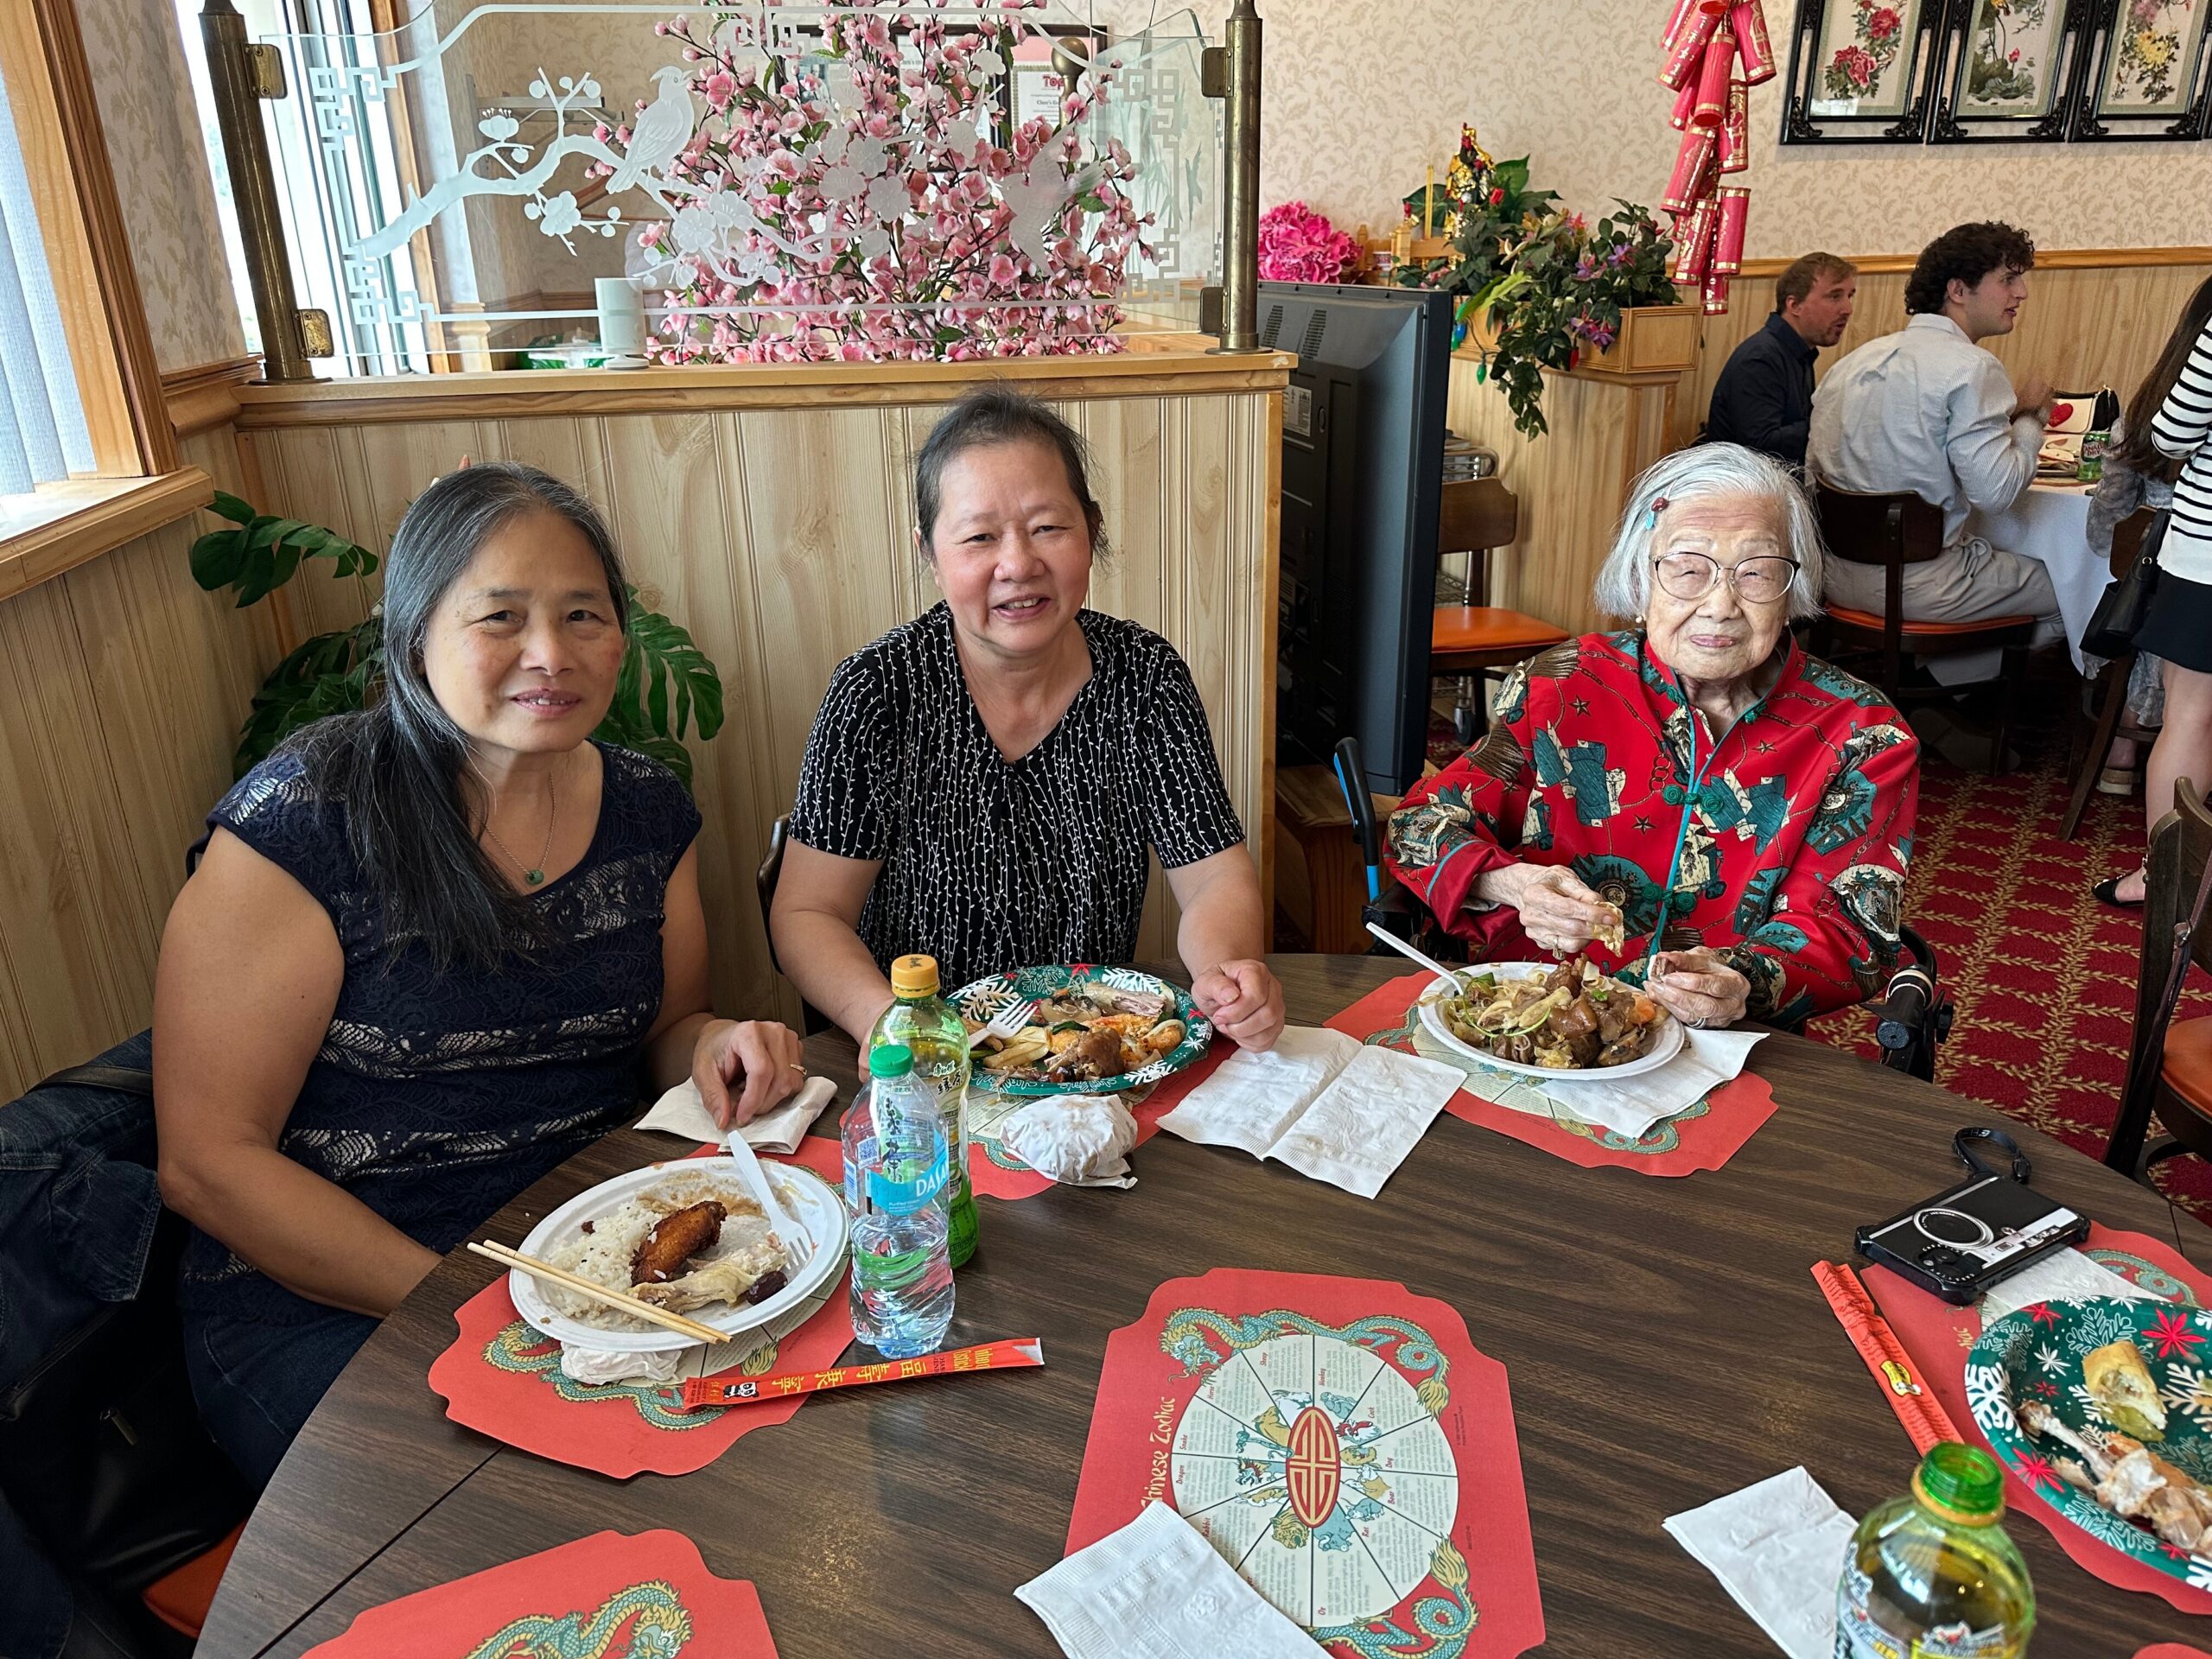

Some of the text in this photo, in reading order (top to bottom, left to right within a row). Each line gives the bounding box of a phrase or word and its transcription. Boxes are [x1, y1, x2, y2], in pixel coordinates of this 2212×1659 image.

[916, 1160, 949, 1198] DASA
[1149, 1396, 1176, 1445] Zodiac
[1179, 1433, 1188, 1451] Snake
[1385, 1457, 1394, 1468] Dog
[1176, 1465, 1185, 1484] Dragon
[1202, 1516, 1211, 1537] Rabbit
